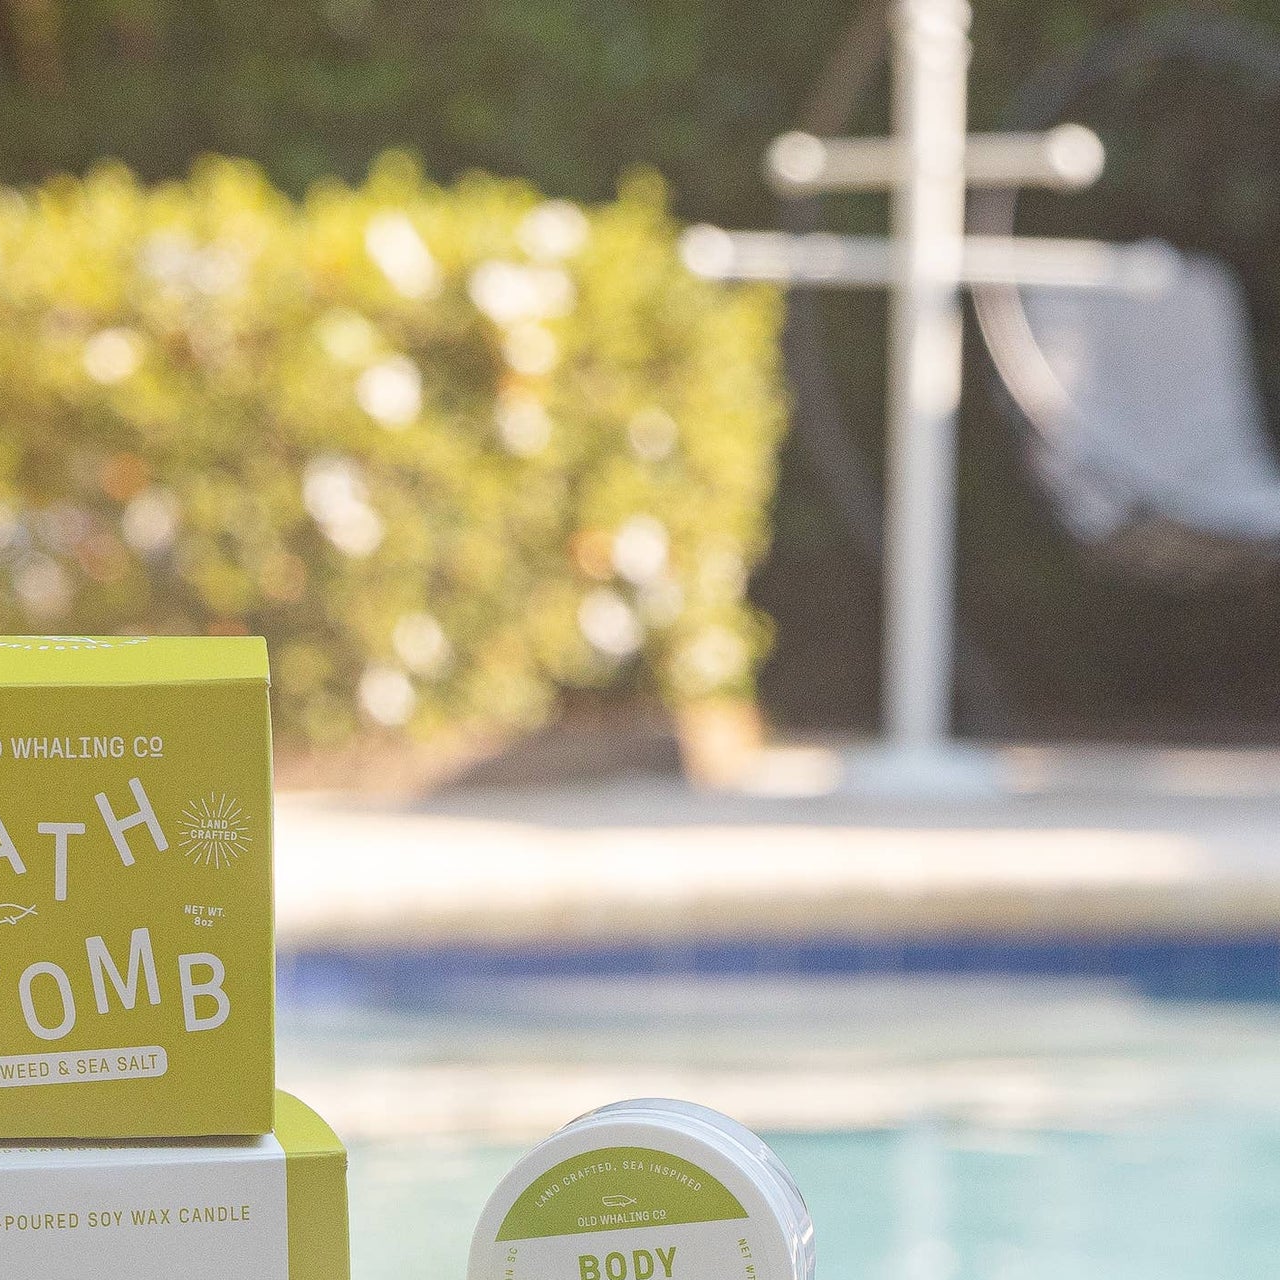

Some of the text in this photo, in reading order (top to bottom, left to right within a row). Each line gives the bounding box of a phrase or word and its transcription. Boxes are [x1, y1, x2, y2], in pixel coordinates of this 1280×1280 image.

[10, 736, 125, 760] WHALING
[190, 829, 238, 841] CRAFTED
[200, 819, 228, 830] LAND
[184, 904, 226, 918] NET WT.
[58, 1060, 70, 1076] &
[76, 1058, 110, 1075] SEA
[117, 1054, 158, 1072] SALT
[535, 1184, 560, 1208] LAND
[623, 1160, 644, 1171] SEA
[649, 1163, 702, 1192] INSPIRED
[87, 1210, 123, 1228] SOY
[130, 1208, 171, 1226] WAX
[179, 1204, 251, 1223] CANDLE
[577, 1215, 598, 1227] OLD
[599, 1211, 650, 1225] WHALING
[737, 1237, 752, 1259] NET
